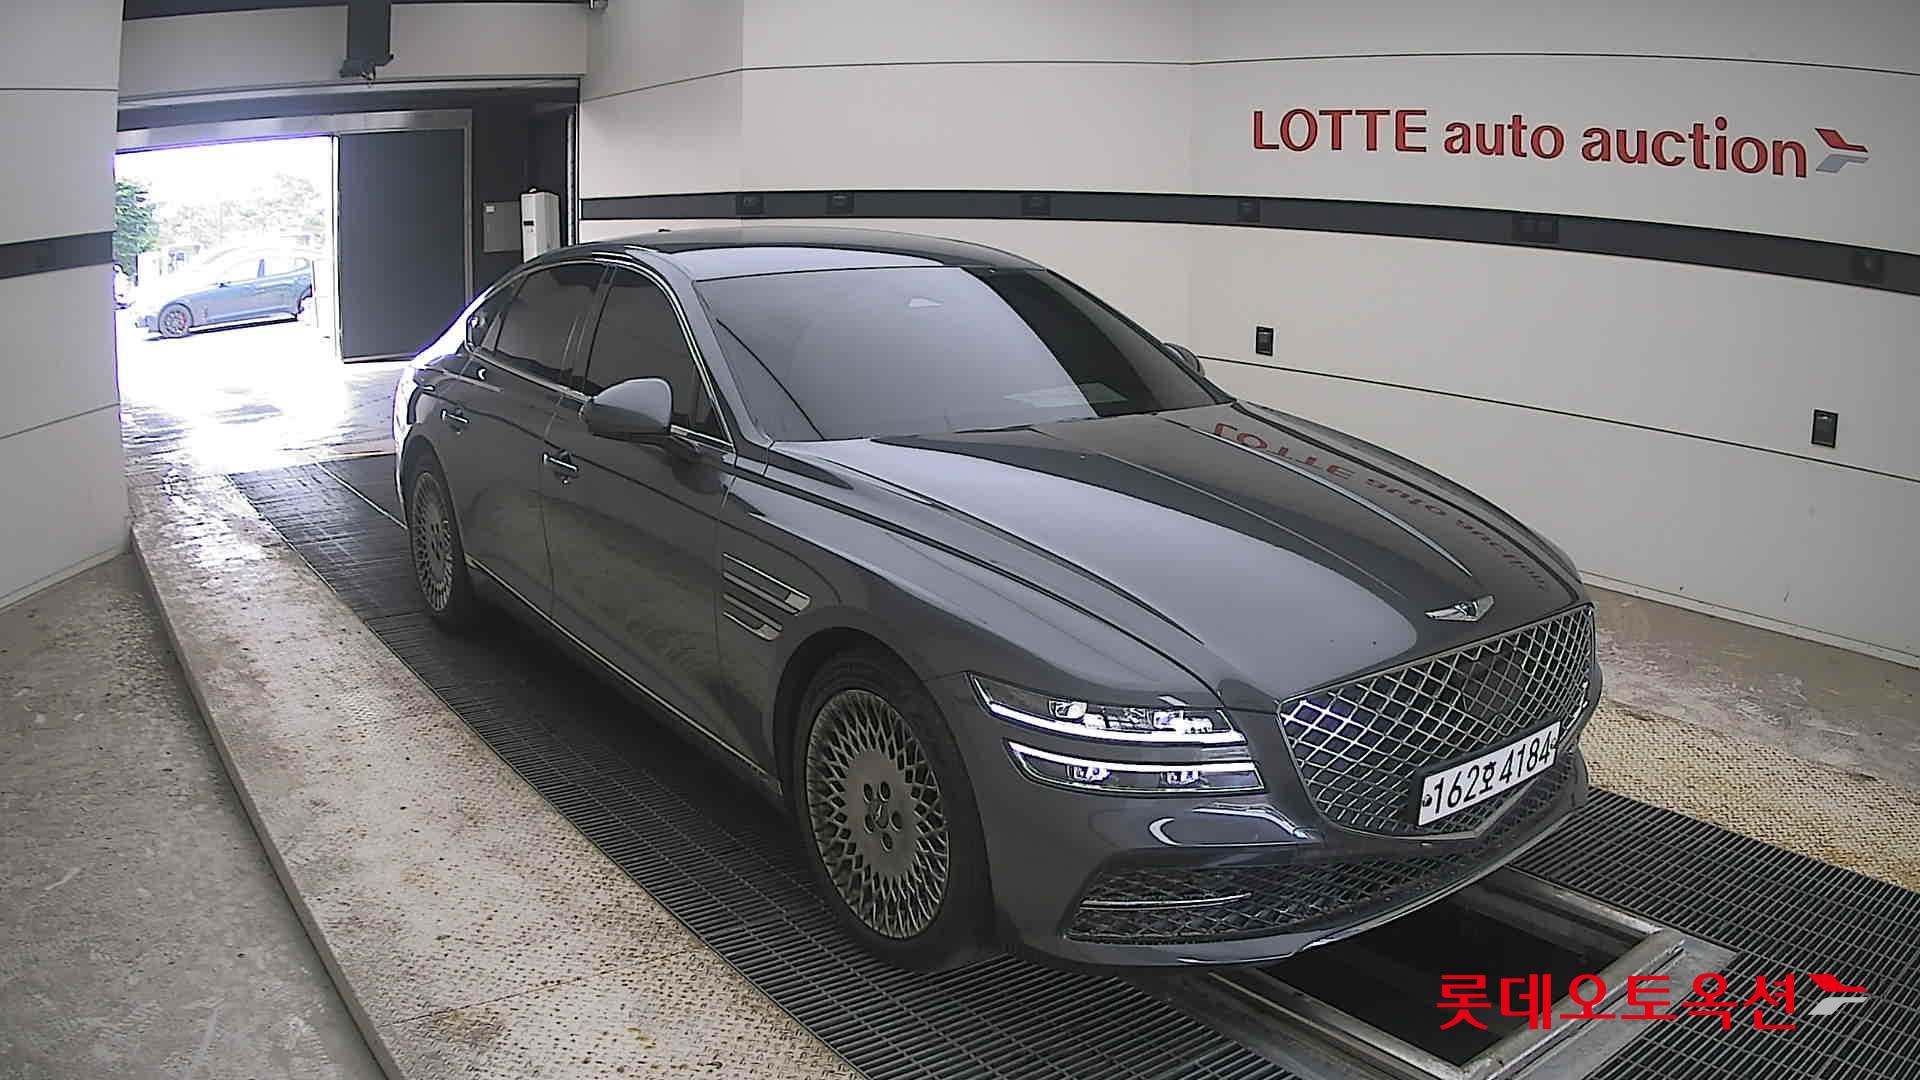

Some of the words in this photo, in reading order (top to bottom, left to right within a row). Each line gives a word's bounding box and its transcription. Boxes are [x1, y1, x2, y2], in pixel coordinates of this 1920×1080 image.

[1252, 108, 1428, 153] LOTTE
[1443, 113, 1566, 159] auto
[1580, 114, 1808, 179] auction
[1433, 760, 1497, 814] 162호
[1499, 730, 1552, 785] 4184
